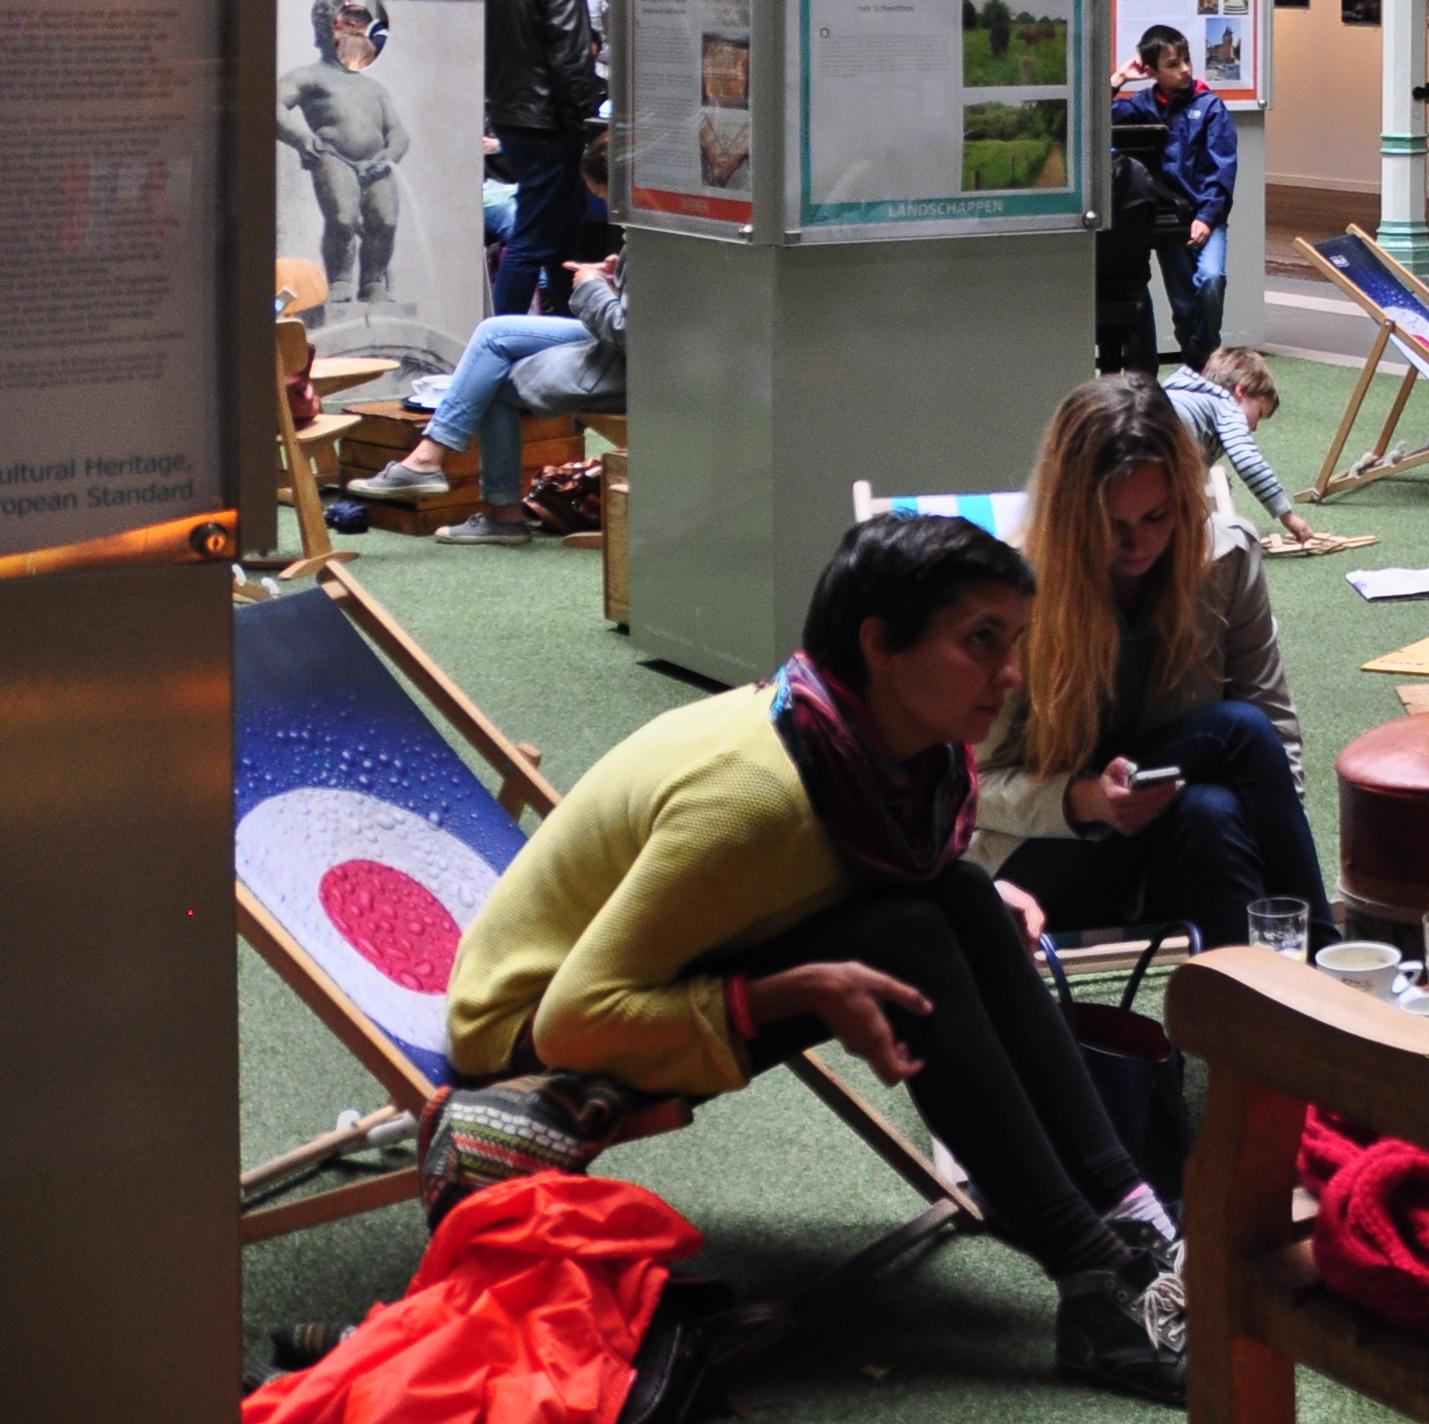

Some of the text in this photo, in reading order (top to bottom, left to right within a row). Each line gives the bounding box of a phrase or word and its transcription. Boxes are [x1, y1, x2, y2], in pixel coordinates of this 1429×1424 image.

[888, 200, 1004, 218] LANDSCHAPPEN
[85, 454, 192, 478] Heritage,
[87, 480, 194, 508] Standard
